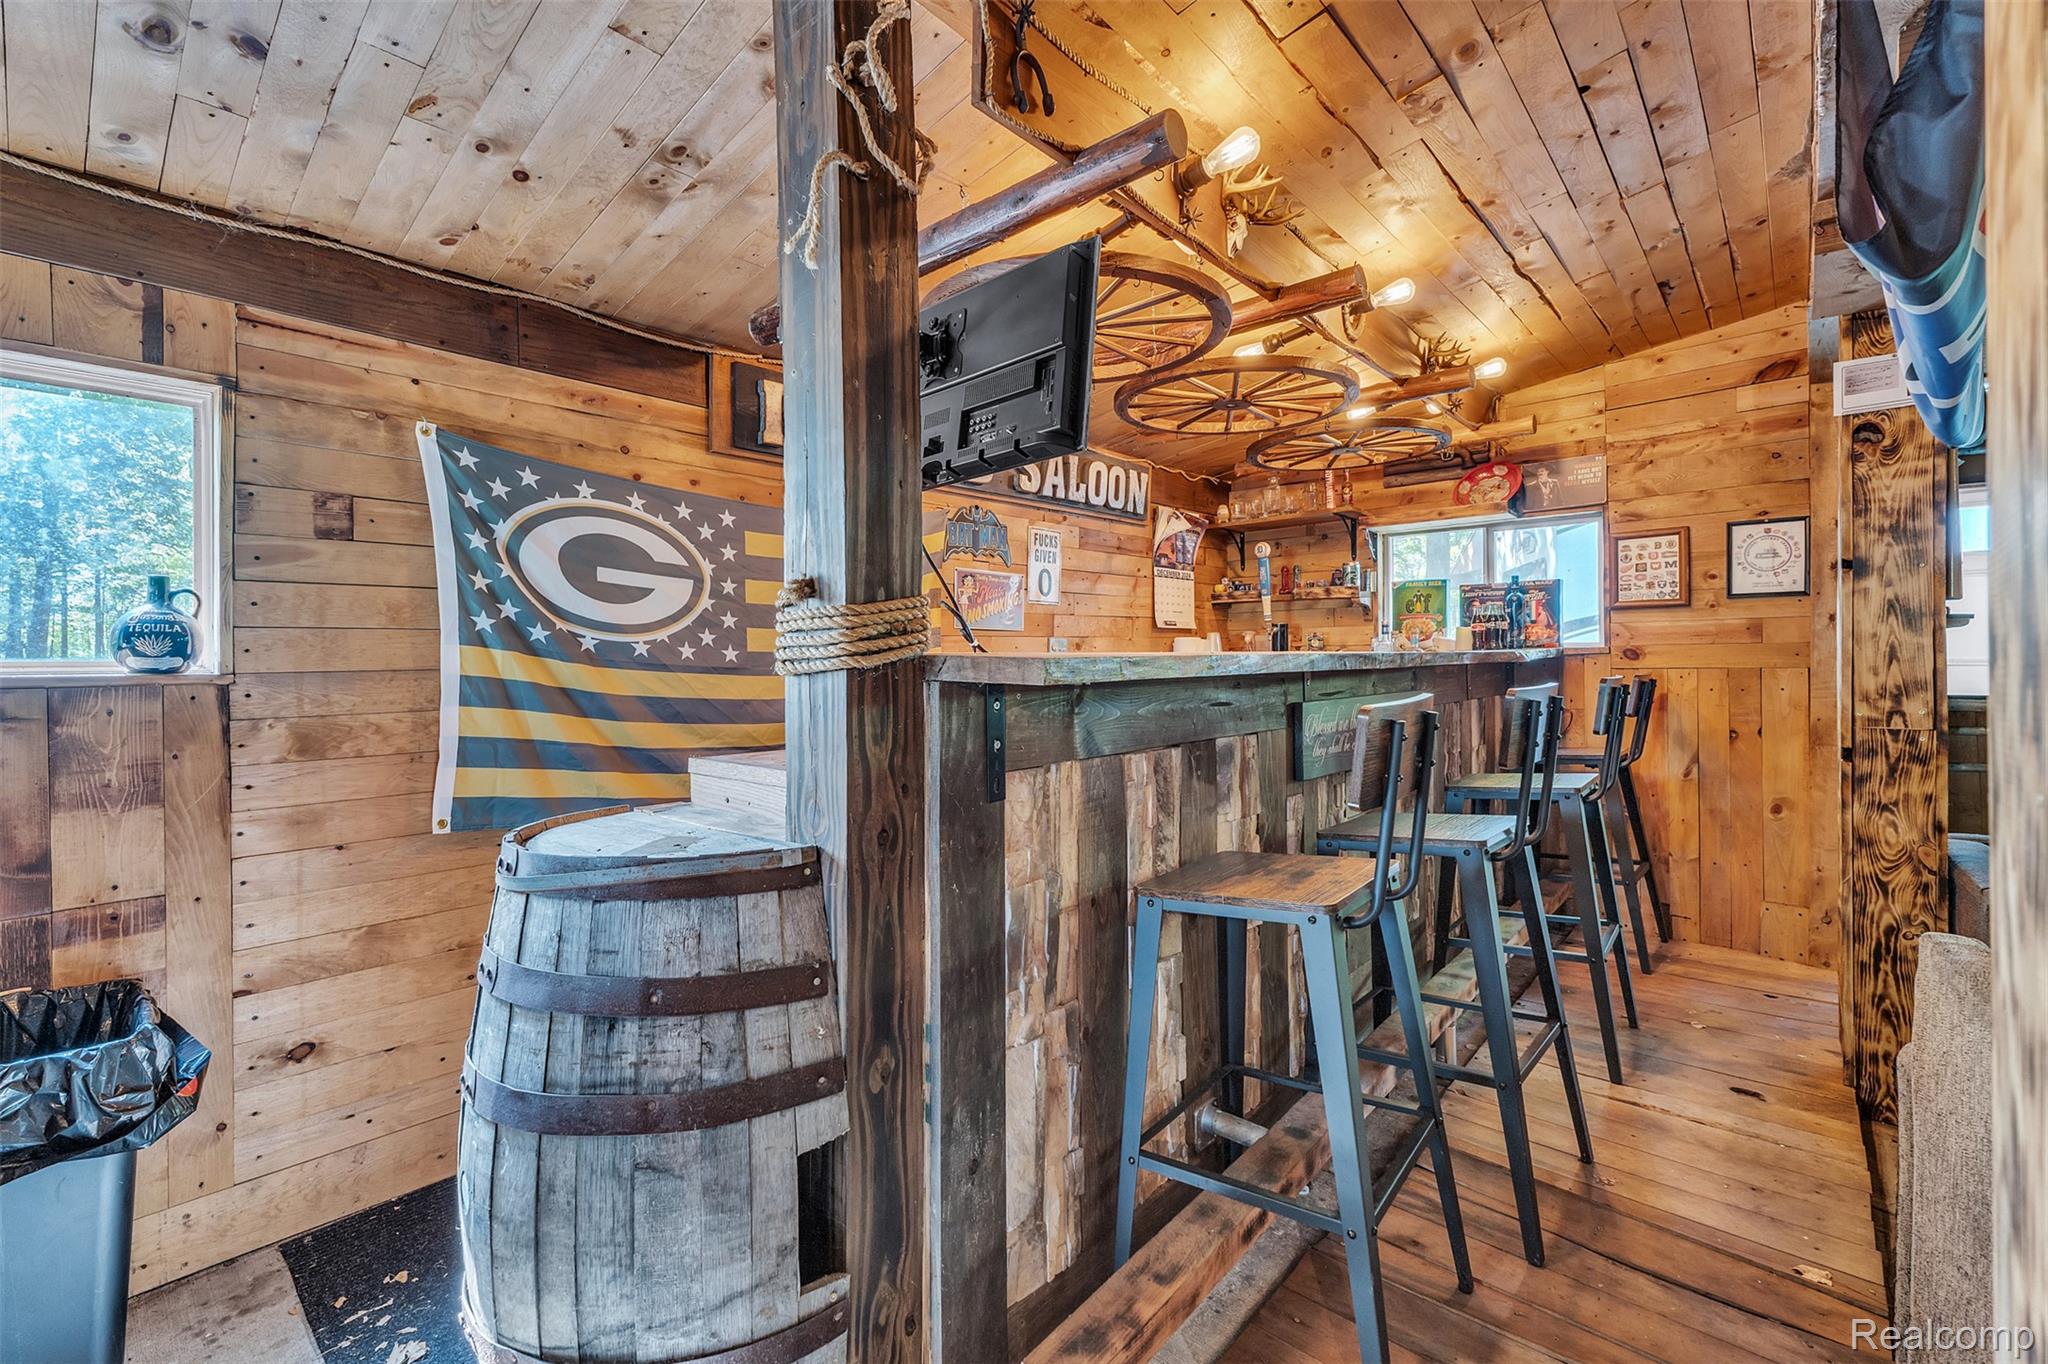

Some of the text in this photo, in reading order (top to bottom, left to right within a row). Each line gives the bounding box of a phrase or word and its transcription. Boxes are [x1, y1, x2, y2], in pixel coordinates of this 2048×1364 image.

[1019, 455, 1149, 515] SALOON
[1033, 532, 1059, 549] FUCKS
[1034, 549, 1058, 565] GIVEN
[519, 515, 695, 624] G
[1156, 568, 1181, 578] DECEMBER
[967, 606, 982, 625] NO
[127, 623, 182, 634] TEQUILA
[1304, 706, 1344, 745] Blessed
[1312, 736, 1327, 768] they
